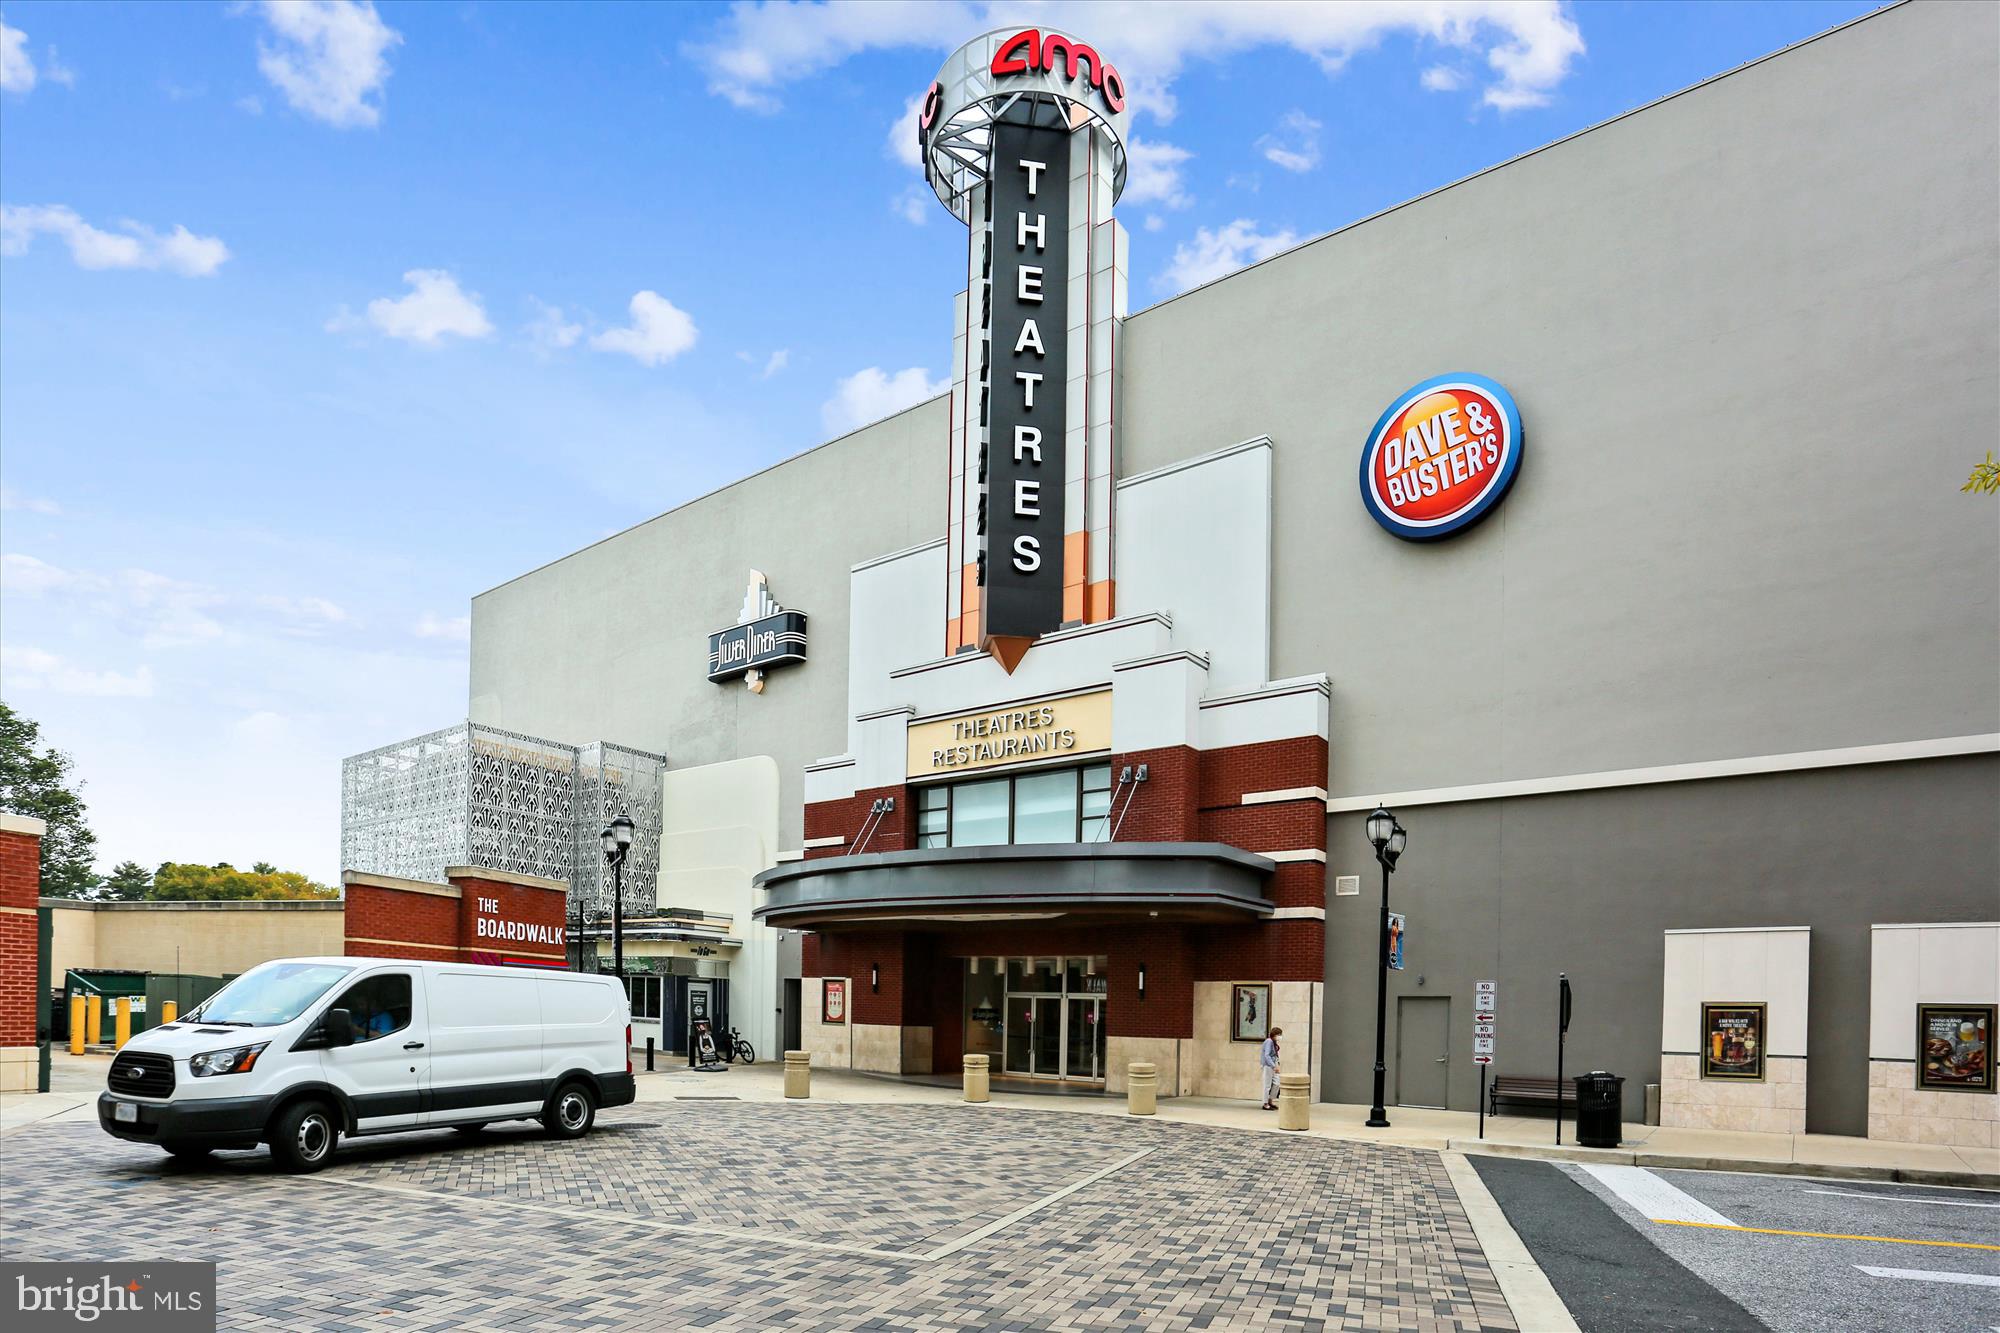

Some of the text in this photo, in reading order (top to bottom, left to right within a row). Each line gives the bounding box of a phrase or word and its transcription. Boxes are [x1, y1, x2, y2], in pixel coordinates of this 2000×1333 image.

[1013, 159, 1047, 573] THEATRES
[1384, 401, 1495, 478] DAVE &
[1386, 432, 1498, 508] BUSTER'S
[714, 633, 746, 672] SILVER
[952, 706, 1053, 741] THEATRES
[932, 728, 1075, 767] RESTAURANTS
[477, 896, 499, 914] THE
[477, 917, 564, 945] BOARDWALK
